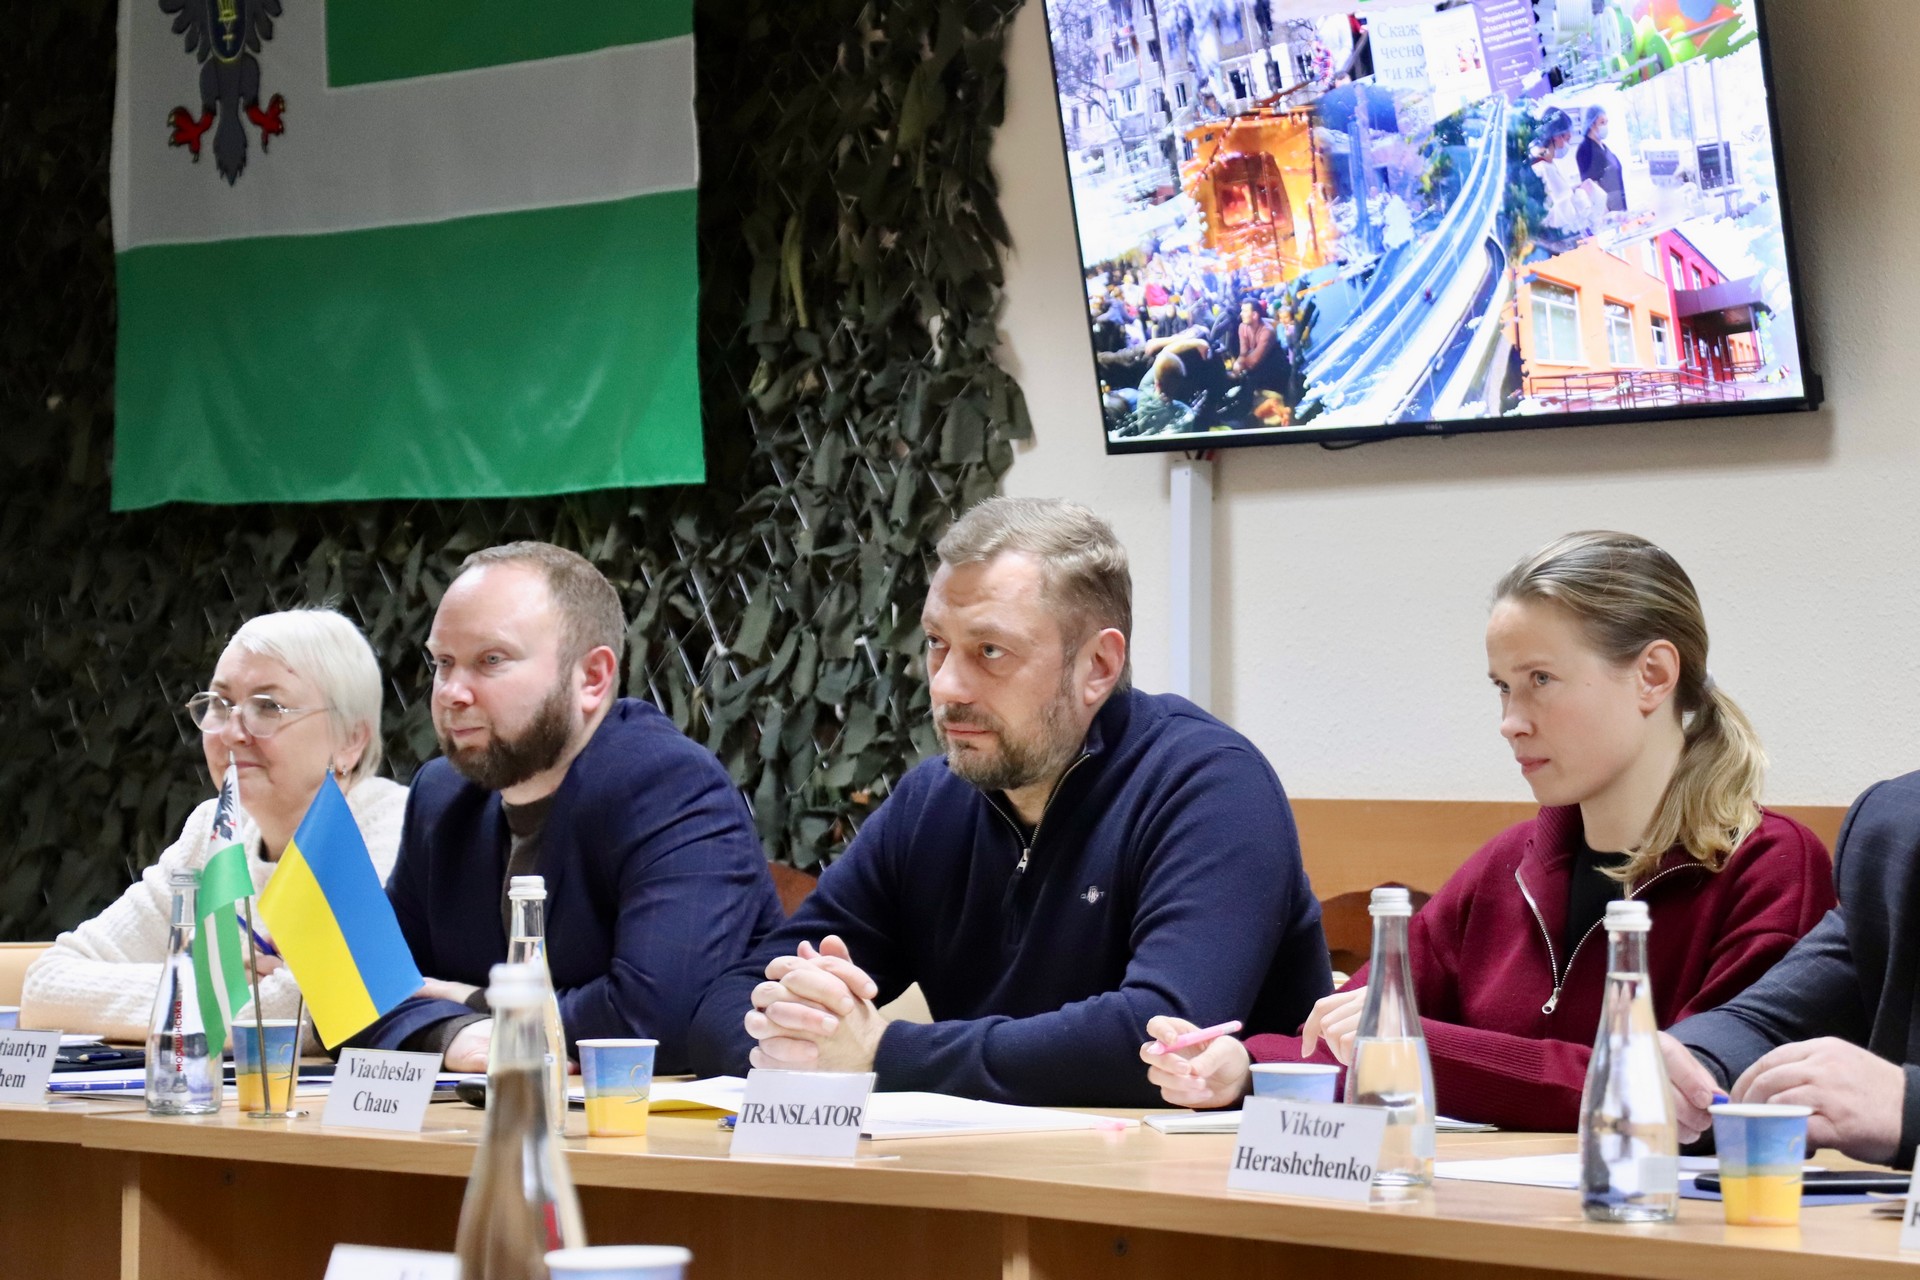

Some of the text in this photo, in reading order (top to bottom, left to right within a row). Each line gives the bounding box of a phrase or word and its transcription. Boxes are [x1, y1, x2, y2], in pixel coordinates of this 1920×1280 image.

[350, 1057, 425, 1082] Viacheslav
[353, 1090, 399, 1114] Chaus
[742, 1103, 862, 1127] TRANSLATOR
[1280, 1110, 1345, 1139] Viktor
[1234, 1145, 1372, 1182] Herashchenko
